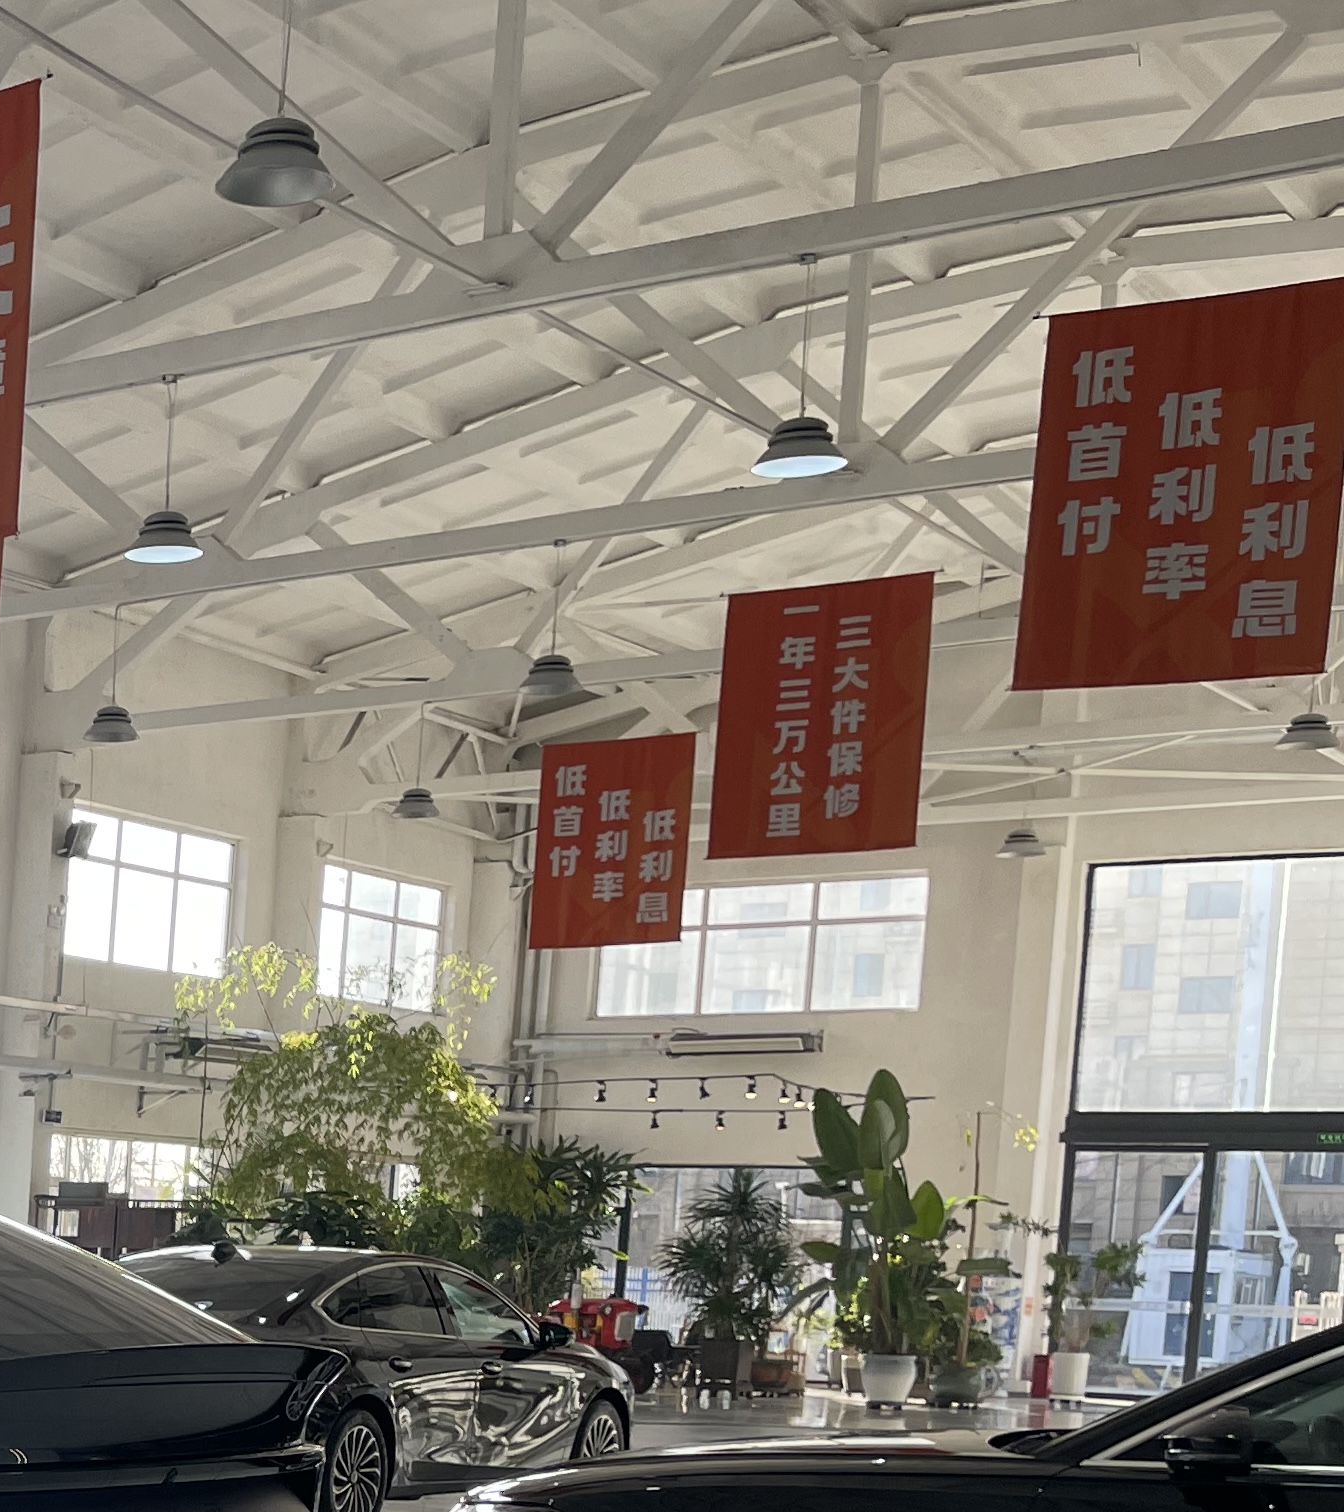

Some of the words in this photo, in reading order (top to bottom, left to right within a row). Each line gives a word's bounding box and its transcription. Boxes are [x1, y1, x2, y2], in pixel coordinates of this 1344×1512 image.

[1057, 345, 1135, 558] 低首付
[1142, 387, 1222, 600] 低利率
[1231, 421, 1315, 640] 低利息
[548, 764, 588, 878] 低首付
[765, 604, 820, 838] 一年三万公里
[823, 614, 872, 820] 三大件保修
[591, 788, 632, 903] 低利率
[635, 809, 677, 925] 低利息
